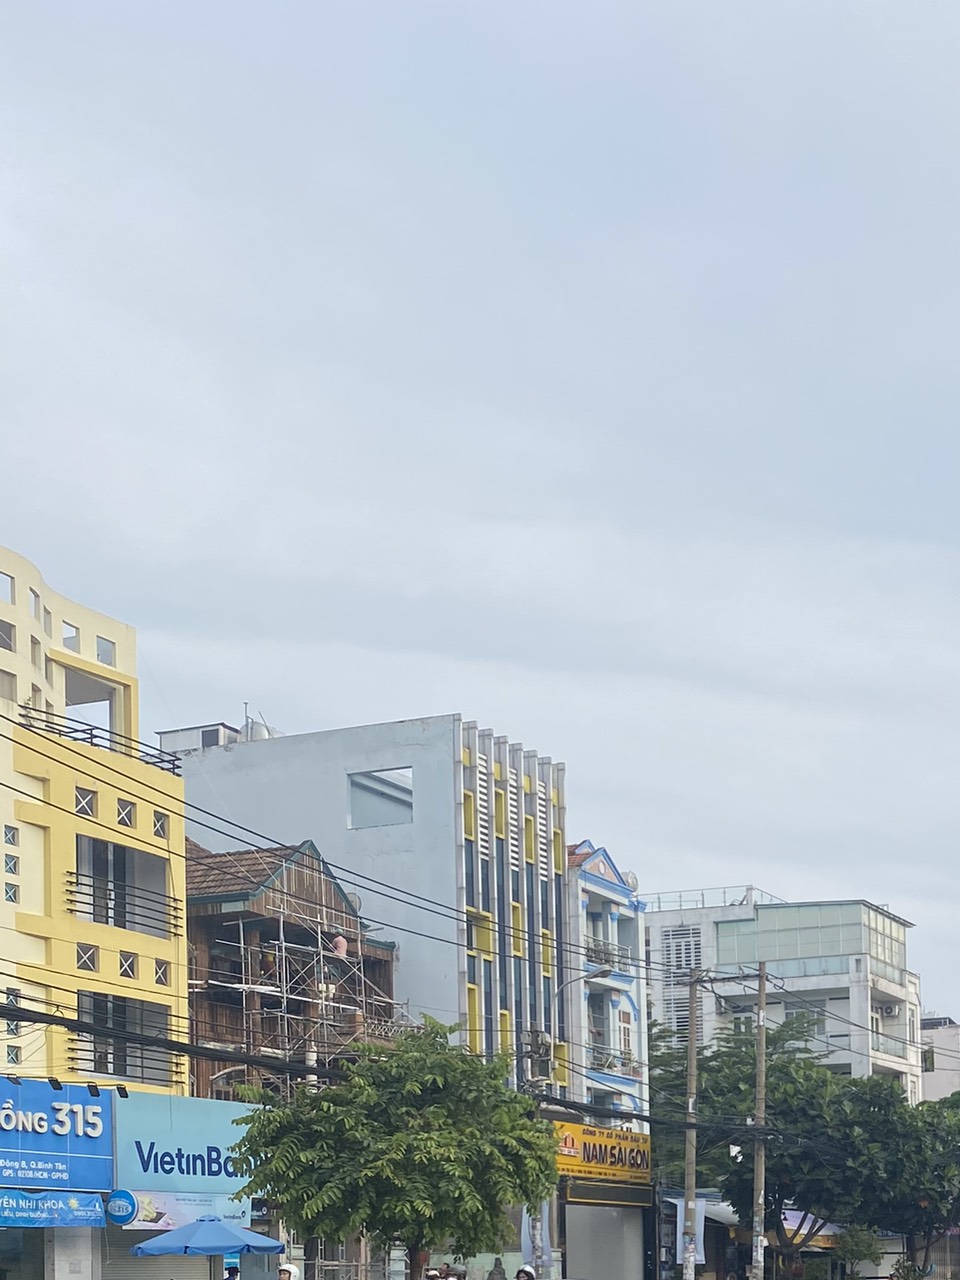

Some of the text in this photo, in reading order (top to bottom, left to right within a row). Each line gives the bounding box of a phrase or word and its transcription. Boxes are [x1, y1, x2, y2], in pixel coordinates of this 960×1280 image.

[51, 1102, 104, 1138] 315
[134, 1140, 254, 1178] VietinBan
[583, 1142, 608, 1164] NAM
[19, 1199, 36, 1209] NHI
[38, 1200, 65, 1210] KHOA
